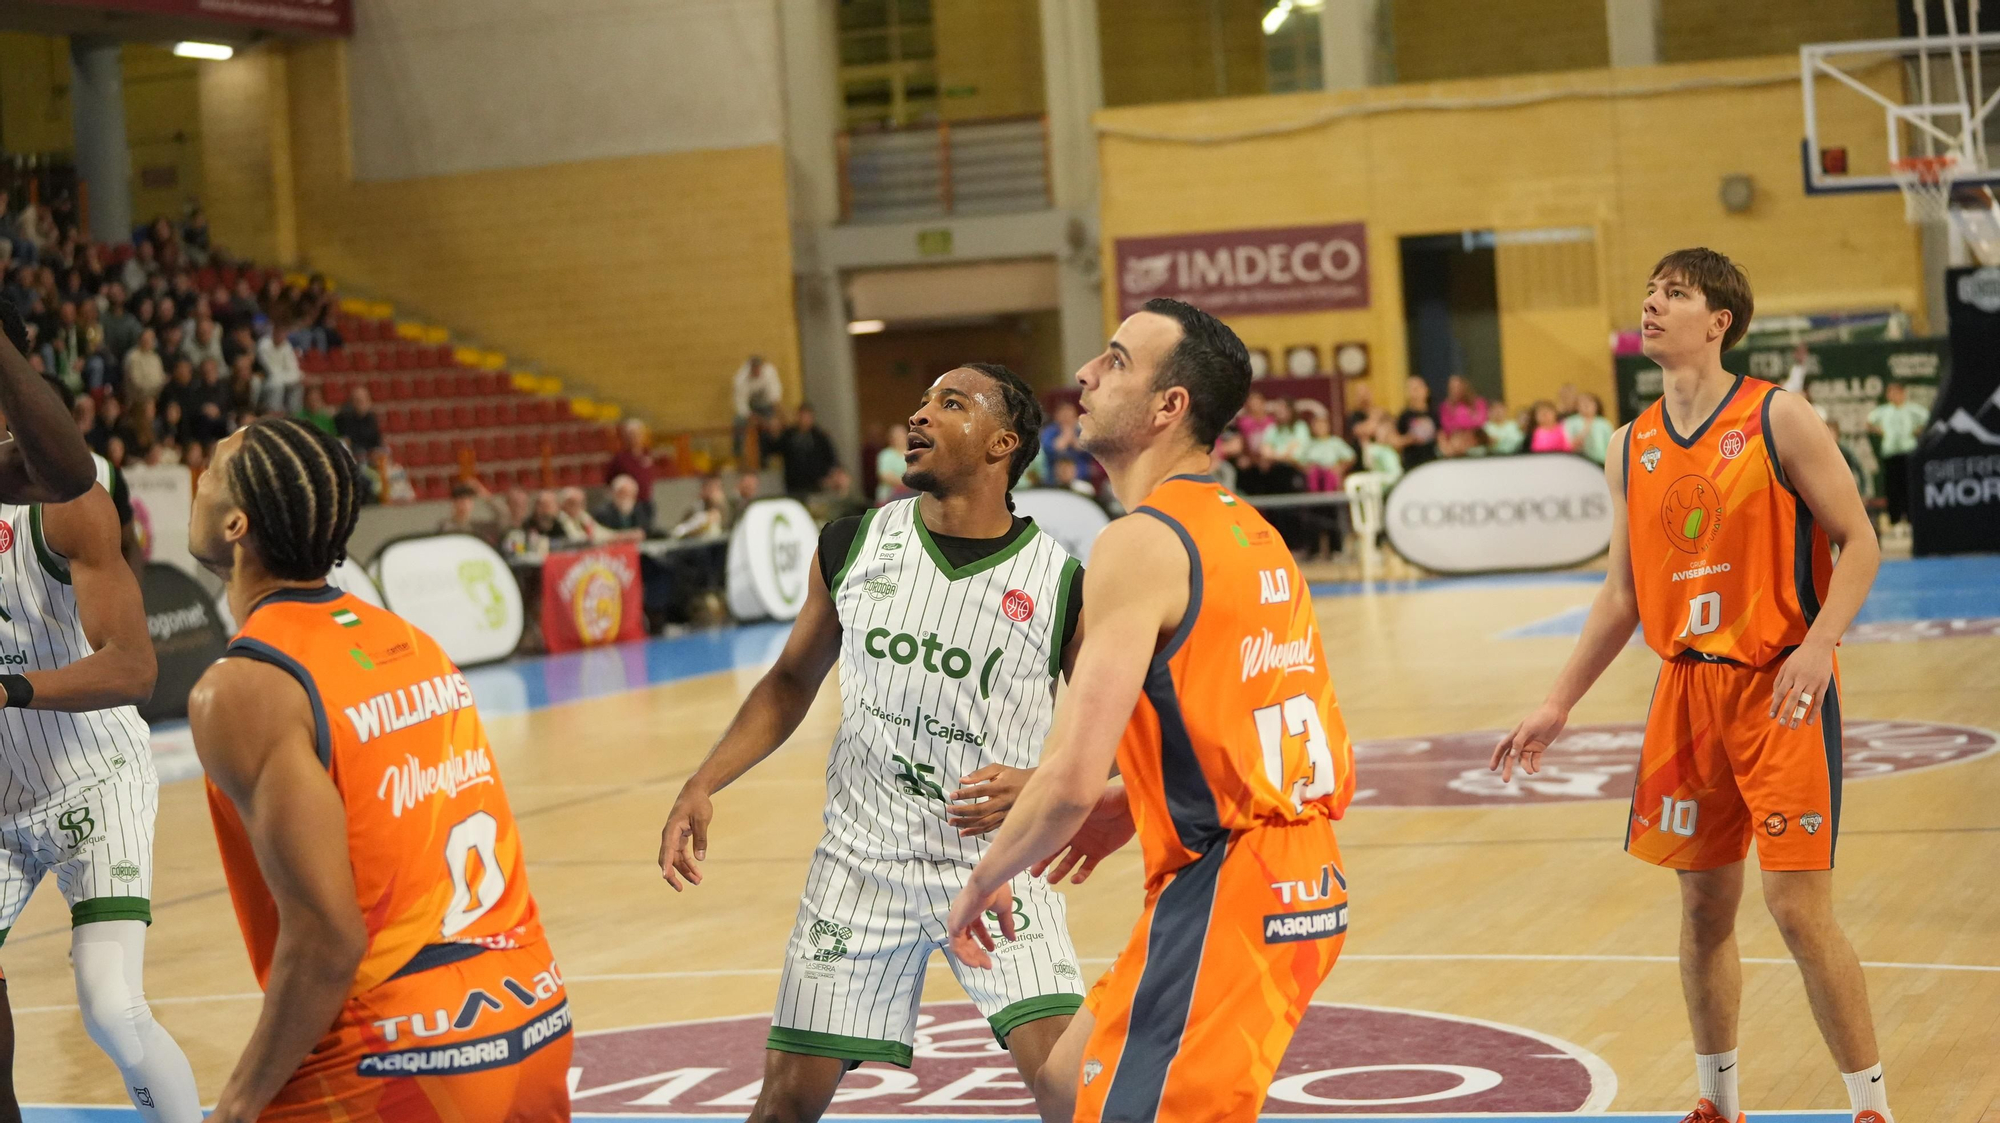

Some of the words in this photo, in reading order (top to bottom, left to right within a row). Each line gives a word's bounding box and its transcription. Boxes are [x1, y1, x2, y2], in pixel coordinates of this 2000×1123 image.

[1177, 239, 1361, 288] IMDECO
[1258, 567, 1290, 605] ALO
[1678, 591, 1721, 638] 10
[865, 627, 971, 679] coto
[344, 673, 474, 744] WILLIAMS
[925, 716, 988, 747] Cajasol
[1252, 693, 1335, 815] 13
[1661, 795, 1698, 837] 10
[441, 810, 506, 938] 0
